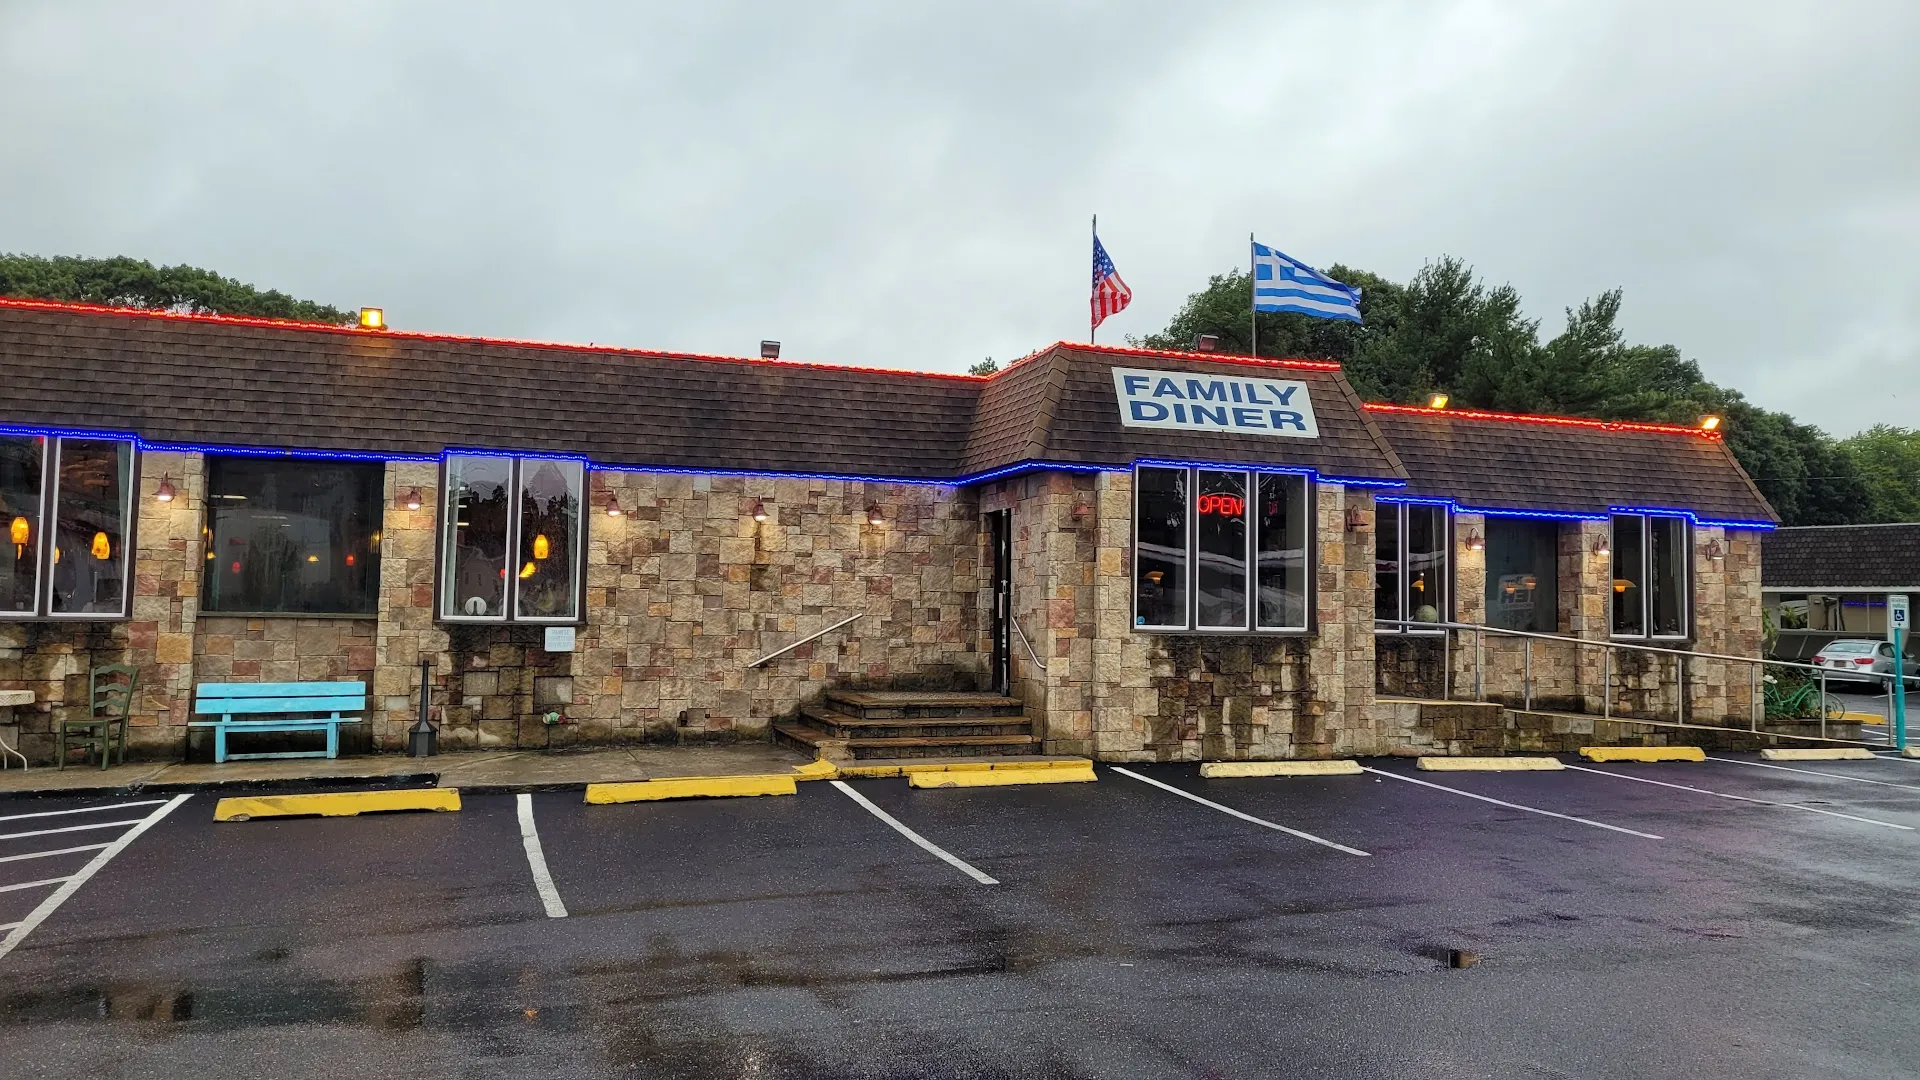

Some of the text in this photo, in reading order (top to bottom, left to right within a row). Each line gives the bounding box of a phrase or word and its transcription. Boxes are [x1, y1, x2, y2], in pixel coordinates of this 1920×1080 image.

[1123, 375, 1298, 406] FAMILY
[1129, 400, 1307, 431] DINER
[1198, 496, 1243, 515] OPEN
